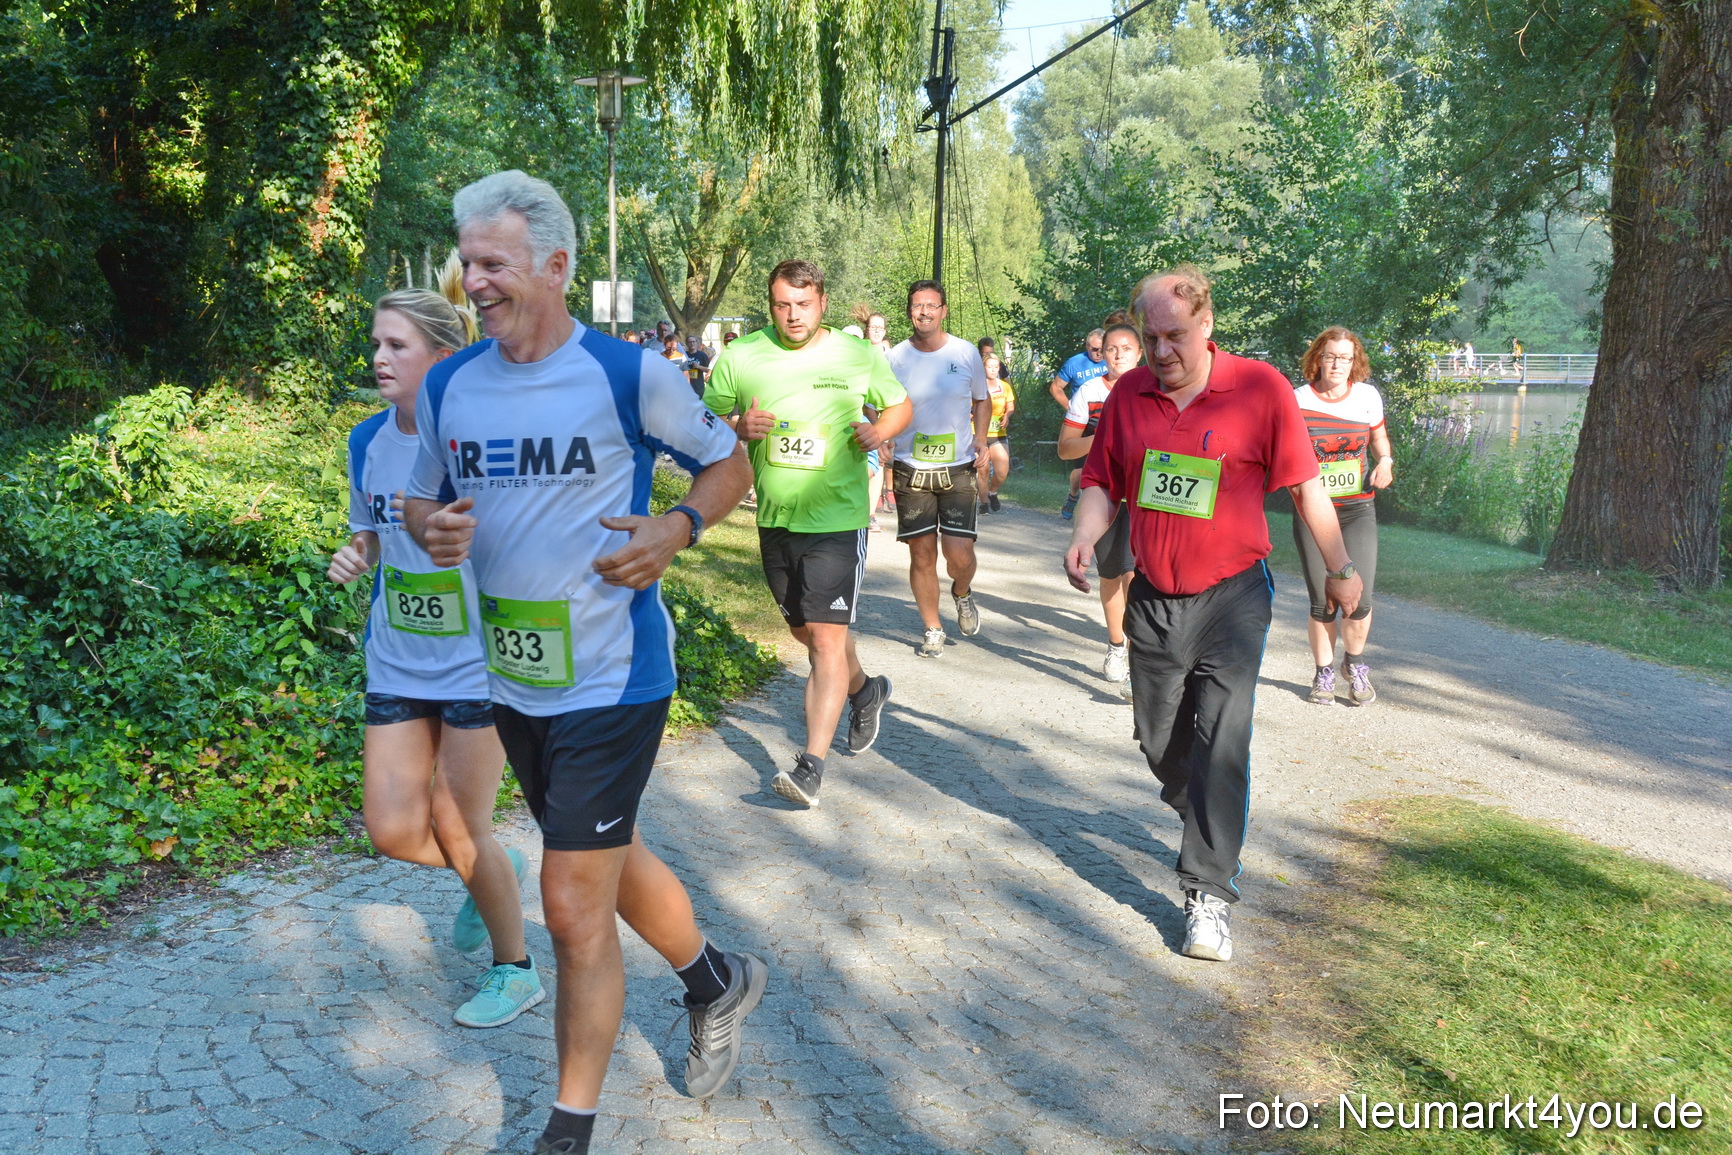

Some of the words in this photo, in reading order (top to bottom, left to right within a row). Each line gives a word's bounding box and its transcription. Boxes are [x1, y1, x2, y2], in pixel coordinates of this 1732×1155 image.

[780, 437, 814, 456] 342
[922, 444, 946, 455] 479
[490, 479, 528, 488] FILTER
[533, 478, 596, 488] Technology
[1155, 473, 1199, 498] 367
[1320, 473, 1354, 487] 1900
[1151, 493, 1174, 502] Hassold
[1175, 497, 1198, 506] Richard
[398, 593, 444, 619] 826
[493, 626, 544, 662] 833
[521, 663, 549, 674] Ludwig
